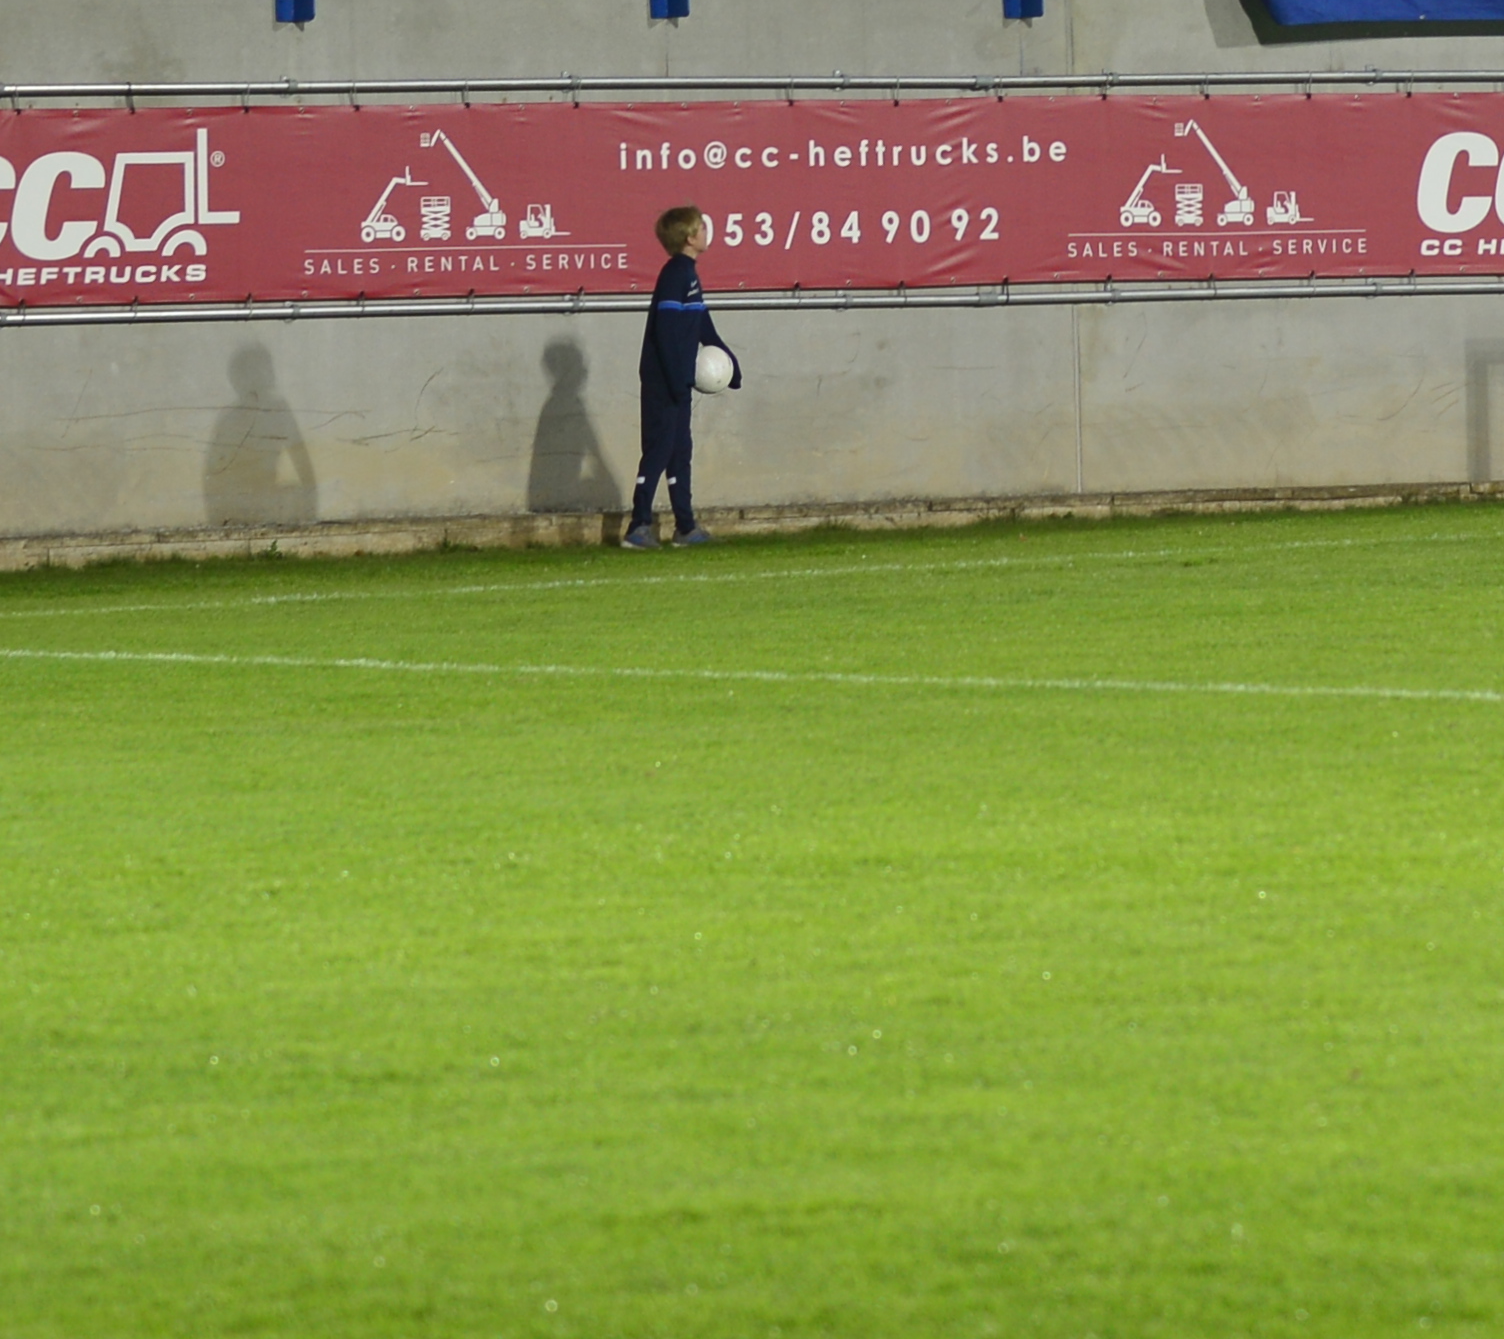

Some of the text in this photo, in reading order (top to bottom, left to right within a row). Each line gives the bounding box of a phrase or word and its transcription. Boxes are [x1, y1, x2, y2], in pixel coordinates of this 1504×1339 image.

[618, 134, 1068, 172] info@cc-heftrucks.be
[881, 209, 931, 245] 90
[951, 206, 1001, 241] 92
[1067, 237, 1368, 259] SALES RENTAL SERVICE
[1419, 239, 1464, 256] CC
[303, 252, 629, 276] SALES RENTAL SERVICE
